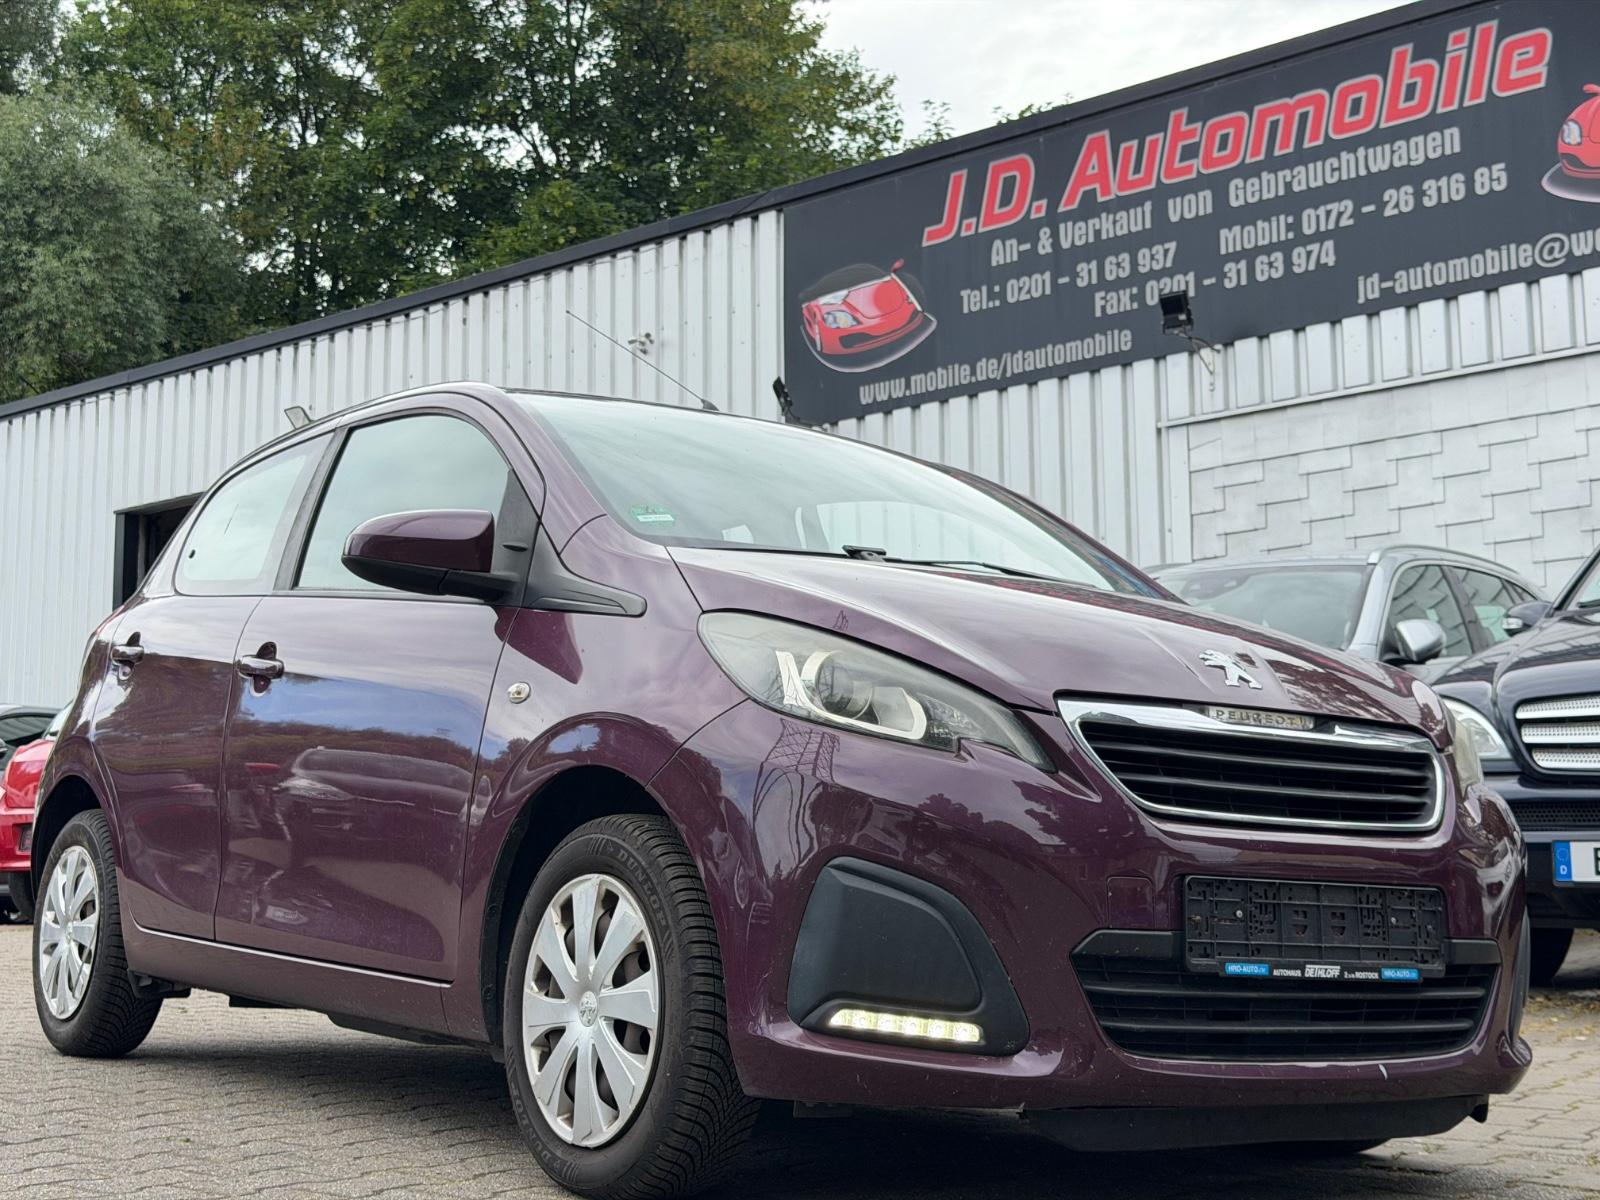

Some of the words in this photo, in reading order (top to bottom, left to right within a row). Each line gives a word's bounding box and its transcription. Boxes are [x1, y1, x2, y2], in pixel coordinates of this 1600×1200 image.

[922, 154, 1047, 247] J.D.
[1058, 19, 1552, 212] Automobile
[990, 238, 1031, 266] An-
[1037, 227, 1053, 257] &
[1058, 201, 1152, 250] Verkauf
[1167, 189, 1213, 223] von
[1228, 126, 1461, 208] Gebrauchtwagen
[1219, 214, 1295, 255] Mobil:
[1301, 199, 1354, 235] 0172
[1383, 184, 1415, 217] 26
[1421, 172, 1466, 208] 316
[1473, 162, 1508, 196] 85
[960, 285, 1000, 314] Tel.:
[1006, 270, 1051, 304] 0201
[1075, 258, 1098, 288] 31
[1104, 252, 1131, 282] 63
[1137, 241, 1177, 274] 937
[1094, 285, 1138, 317] Fax:
[1223, 259, 1248, 289] 31
[1255, 251, 1284, 282] 63
[1291, 239, 1336, 274] 974
[859, 328, 1132, 405] www.mobile.de/jdautomobile
[1216, 709, 1299, 726] PEUGEOT
[617, 850, 668, 926] DUNLOP
[1560, 865, 1568, 875] D
